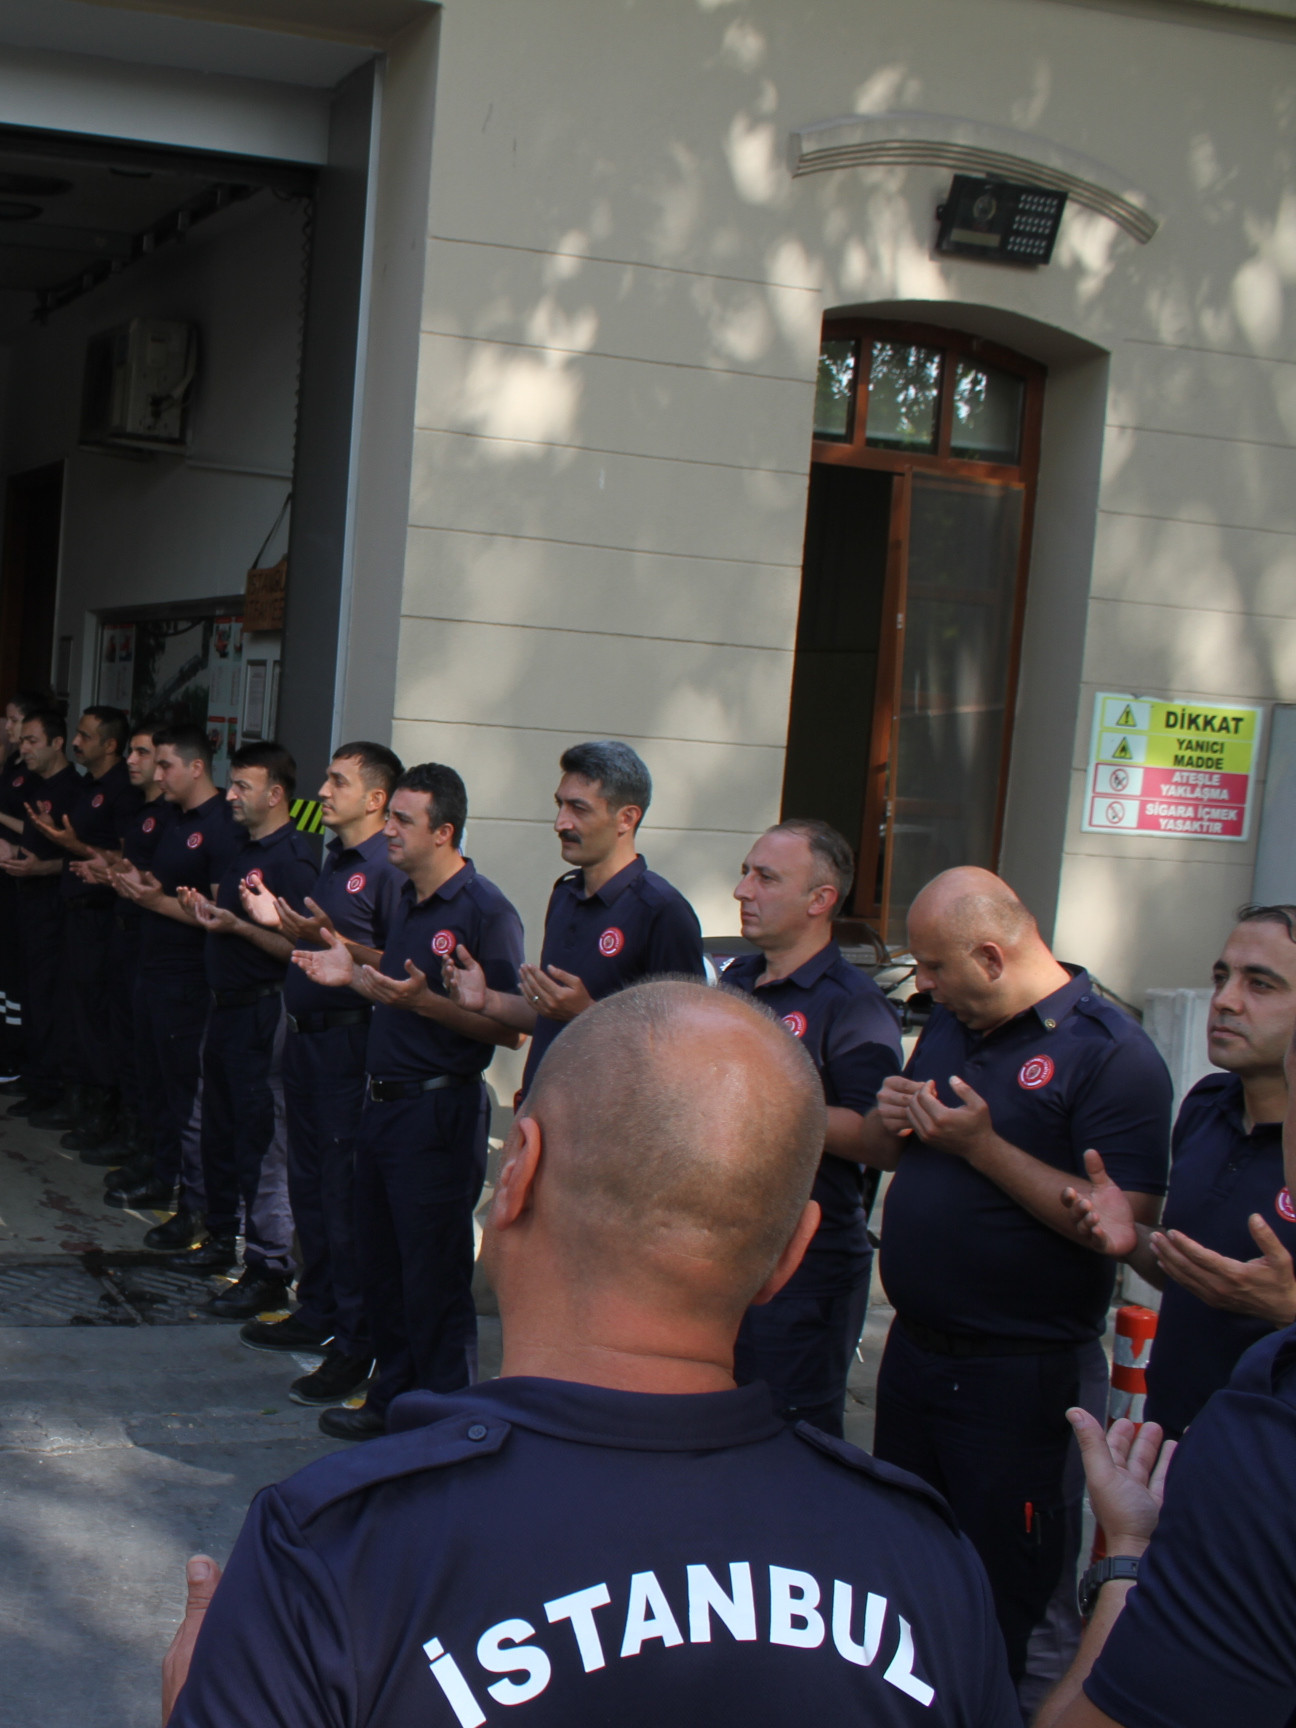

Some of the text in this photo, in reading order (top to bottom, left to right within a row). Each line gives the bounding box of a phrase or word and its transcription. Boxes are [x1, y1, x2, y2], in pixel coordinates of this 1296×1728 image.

[1165, 708, 1244, 735] DİKKAT
[1176, 738, 1225, 754] YANICI
[1173, 755, 1224, 770] MADDE
[1171, 771, 1221, 786] ATEŞLE
[1160, 784, 1230, 802] YAKLAŞMA
[1145, 802, 1239, 823] SİGARA İÇMEK
[1159, 819, 1224, 833] YASAKTIR
[422, 1561, 935, 1728] İSTANBUL
